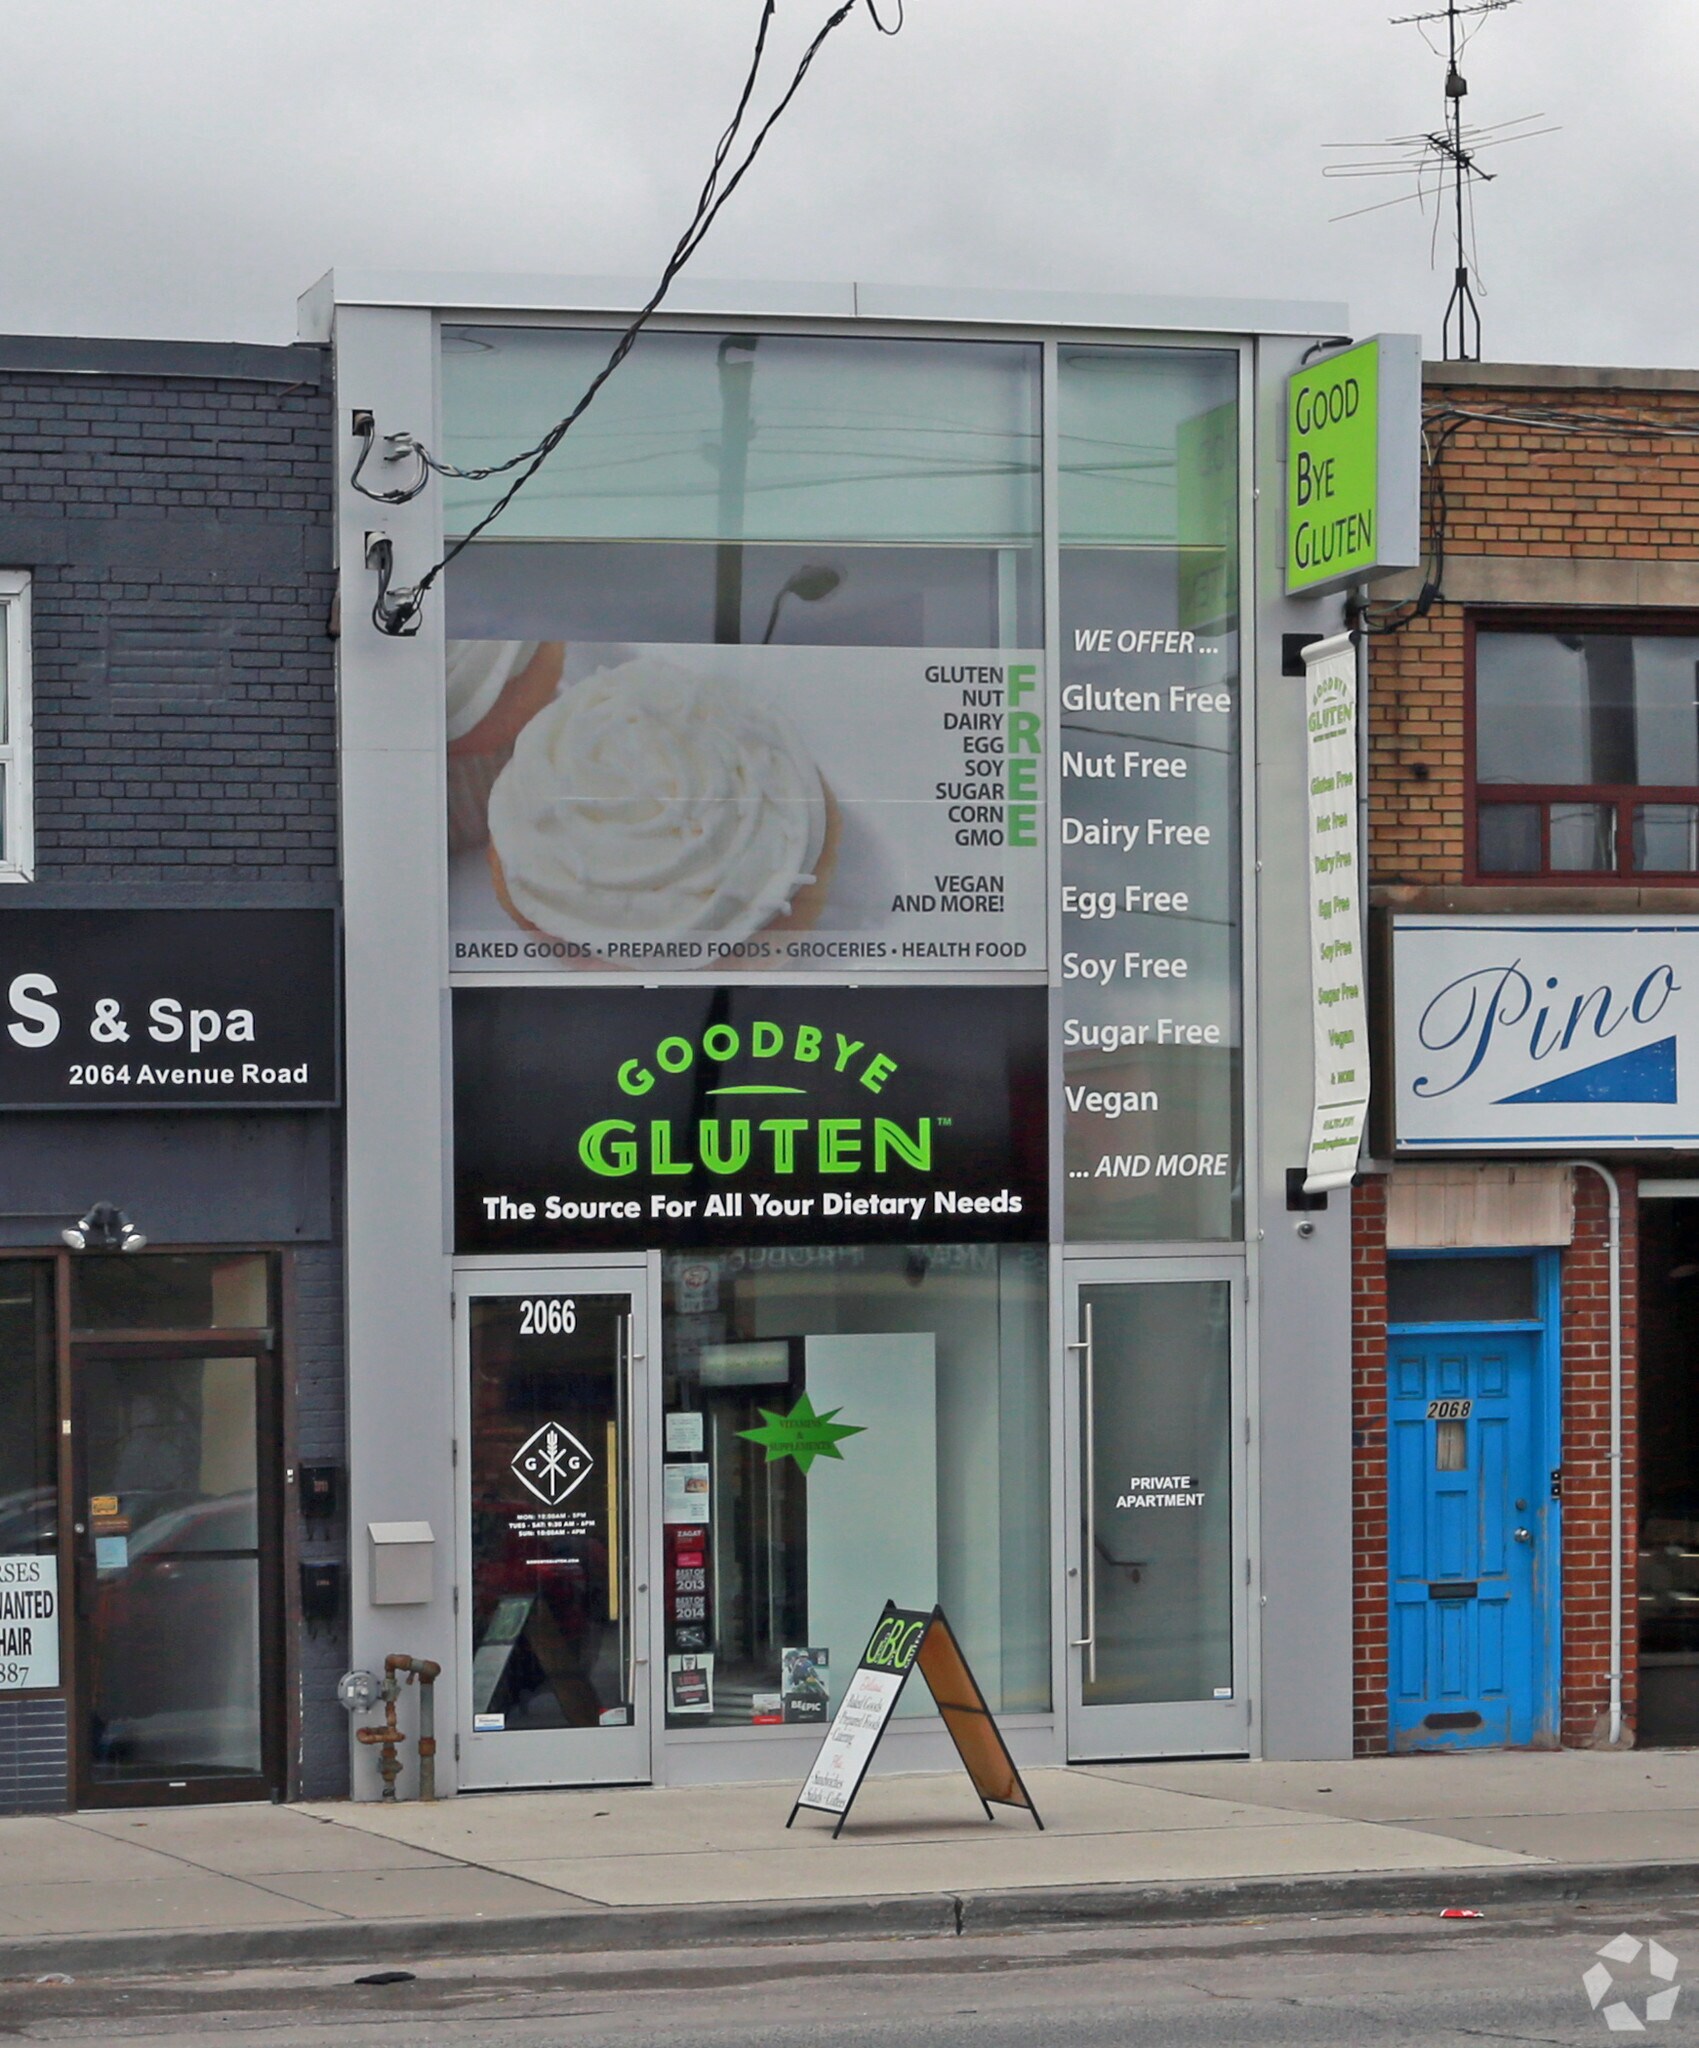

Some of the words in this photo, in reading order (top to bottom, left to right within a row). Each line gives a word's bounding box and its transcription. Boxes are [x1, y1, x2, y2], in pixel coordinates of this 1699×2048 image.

[1296, 378, 1359, 435] GOOD
[1295, 508, 1371, 569] GLUTEN
[1074, 630, 1112, 653] WE
[1117, 630, 1194, 653] OFFER
[925, 666, 1003, 684] GLUTEN
[962, 690, 1004, 707] NUT
[1062, 684, 1160, 713] Gluten
[1170, 686, 1231, 713] Free
[1313, 677, 1348, 706] GOODBYE
[943, 713, 1003, 731] DAIRY
[1308, 702, 1353, 733] GLUTEN
[963, 736, 1004, 754] EGG
[965, 759, 1003, 777] SOY
[1062, 752, 1115, 778] Nut
[1125, 752, 1187, 778] Free
[1336, 771, 1353, 789] Free
[935, 783, 1004, 800] SUGAR
[948, 806, 1004, 823] CORN
[955, 829, 1004, 847] GMO
[1062, 819, 1139, 852] Dairy
[1147, 820, 1210, 846] Free
[934, 876, 1004, 893] VEGAN
[891, 895, 936, 913] AND
[940, 894, 1005, 913] MORE!
[1062, 887, 1116, 918] Egg
[1126, 887, 1188, 912] Free
[455, 943, 518, 959] BAKED
[524, 942, 591, 959] GOODS
[607, 942, 702, 959] PREPARED
[707, 942, 771, 959] FOODS
[786, 942, 886, 959] GROCERIES
[902, 941, 971, 958] HEALTH
[975, 941, 1027, 958] FOOD
[1063, 953, 1117, 986] Soy
[1125, 953, 1188, 979] Free
[1341, 982, 1359, 1000] Free
[90, 998, 130, 1043] &
[148, 998, 255, 1053] Spa
[1063, 1020, 1149, 1052] Sugar
[1157, 1020, 1220, 1046] Free
[1412, 957, 1682, 1099] Pino
[1328, 1029, 1355, 1049] Vegan
[617, 1021, 897, 1096] GOODBYE
[69, 1065, 131, 1085] 2064
[136, 1064, 234, 1084] Avenue
[242, 1063, 309, 1084] Road
[1064, 1087, 1158, 1119] Vegan
[579, 1118, 931, 1176] GLUTEN
[1095, 1155, 1150, 1179] AND
[1155, 1155, 1228, 1177] MORE
[483, 1197, 536, 1220] The
[545, 1196, 641, 1219] Source
[651, 1196, 696, 1218] For
[704, 1194, 742, 1217] All
[749, 1193, 815, 1217] Your
[823, 1192, 926, 1220] Dietary
[934, 1190, 1023, 1215] Needs
[520, 1300, 576, 1335] 2066
[1427, 1401, 1470, 1417] 2068
[1131, 1476, 1190, 1490] PRIVATE
[1116, 1493, 1205, 1508] APARTMENT
[676, 1581, 705, 1590] 2013
[676, 1609, 705, 1618] 2014
